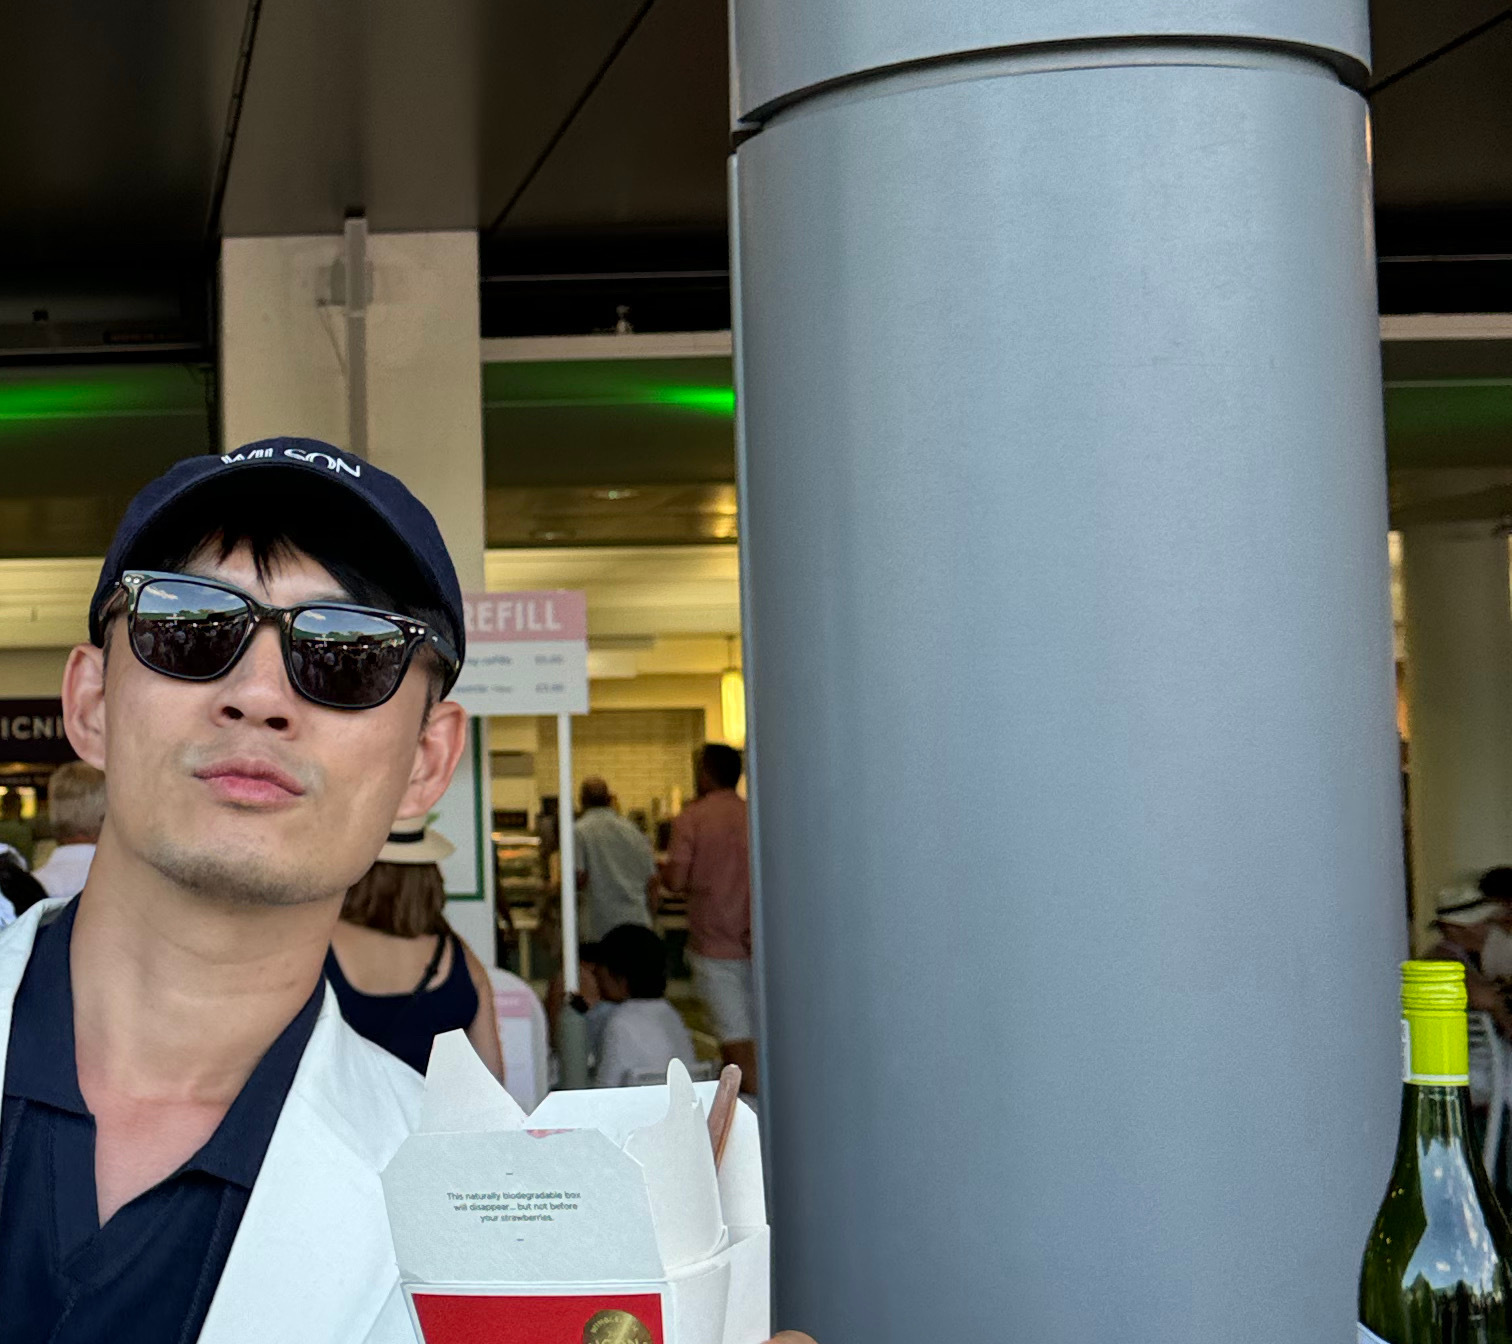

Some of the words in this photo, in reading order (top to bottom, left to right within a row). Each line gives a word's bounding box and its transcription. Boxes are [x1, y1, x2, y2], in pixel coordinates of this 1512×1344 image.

[463, 600, 562, 631] REFILL
[446, 1192, 464, 1201] This
[465, 1191, 501, 1201] naturally
[502, 1191, 563, 1201] biodegradable
[564, 1191, 581, 1199] box
[454, 1203, 468, 1211] will
[517, 1202, 532, 1210] but
[534, 1202, 548, 1210] not
[549, 1202, 578, 1210] before
[480, 1214, 499, 1223] your
